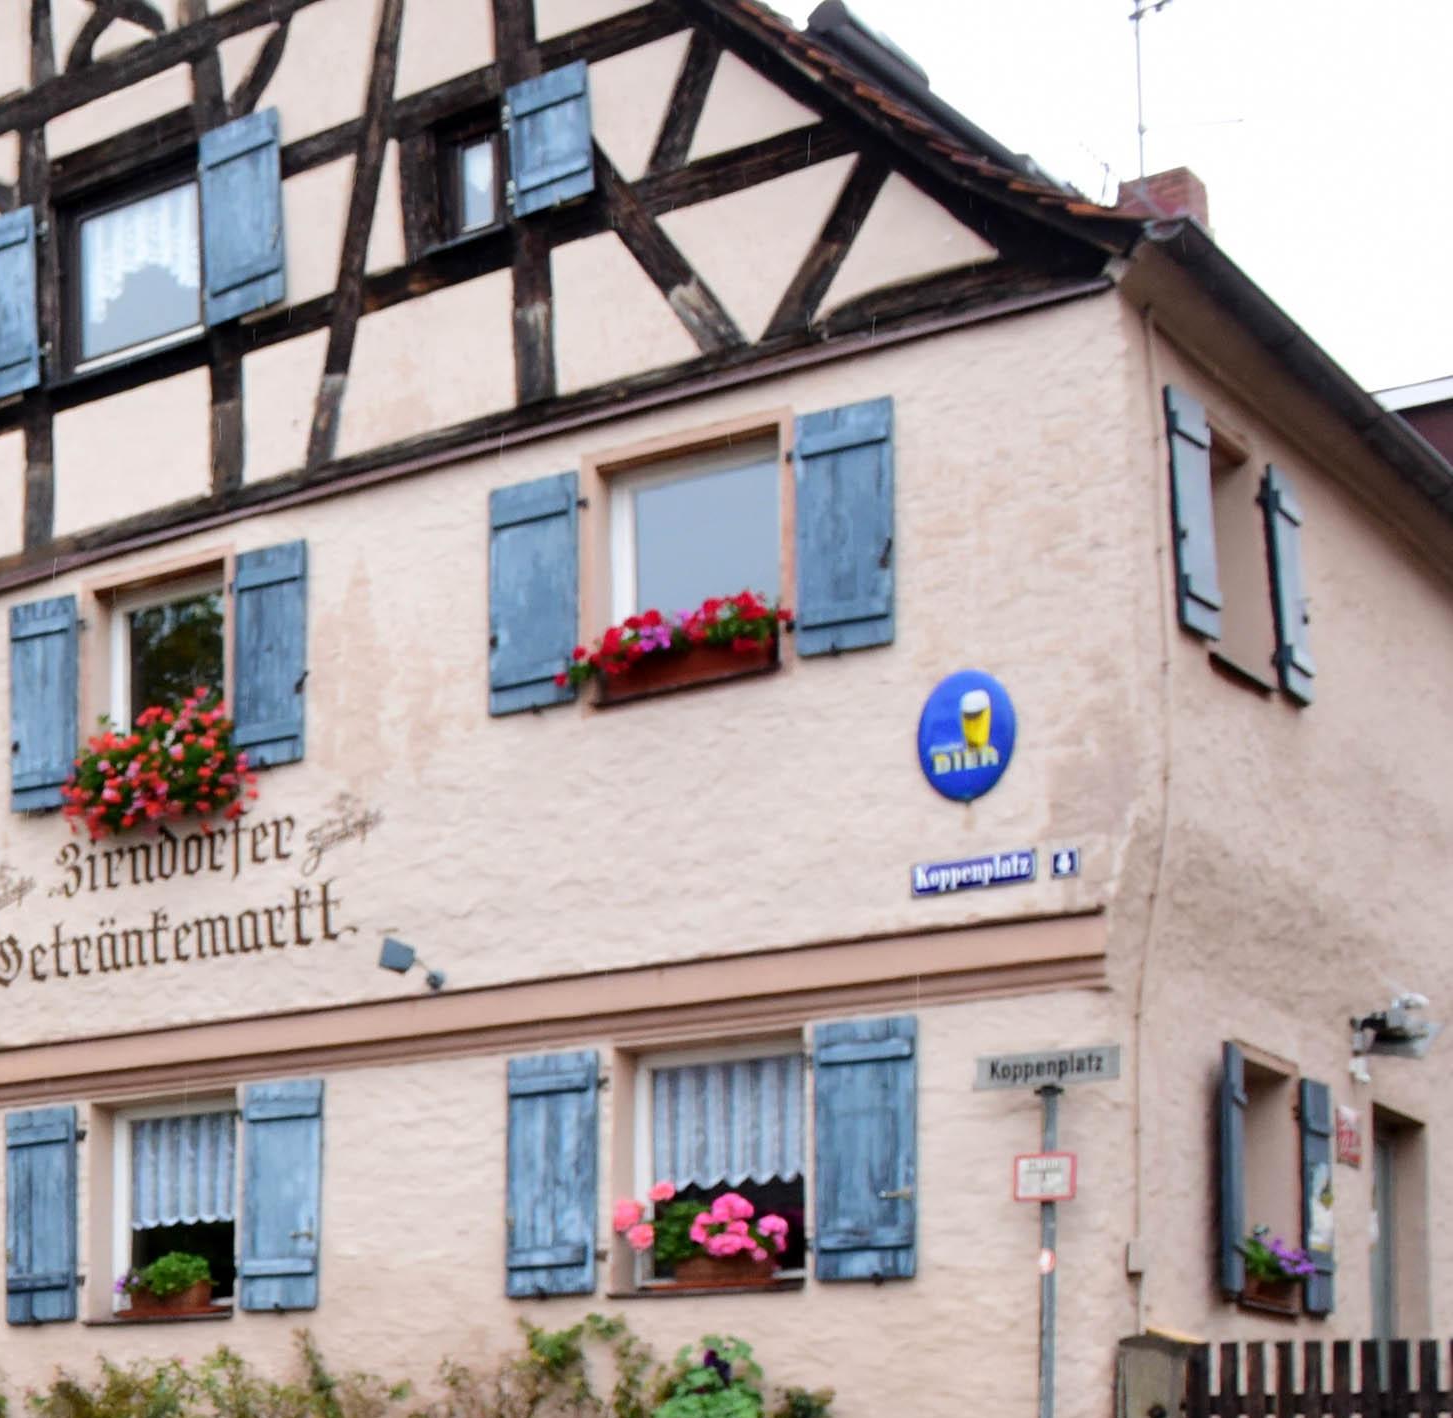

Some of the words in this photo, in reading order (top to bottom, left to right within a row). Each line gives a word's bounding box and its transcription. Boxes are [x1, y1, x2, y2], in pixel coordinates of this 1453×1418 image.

[50, 809, 295, 898] Zirndorfer
[1055, 851, 1071, 874] 4
[914, 854, 1030, 891] Koppenplatz
[989, 1053, 1104, 1084] Koppenplatz
